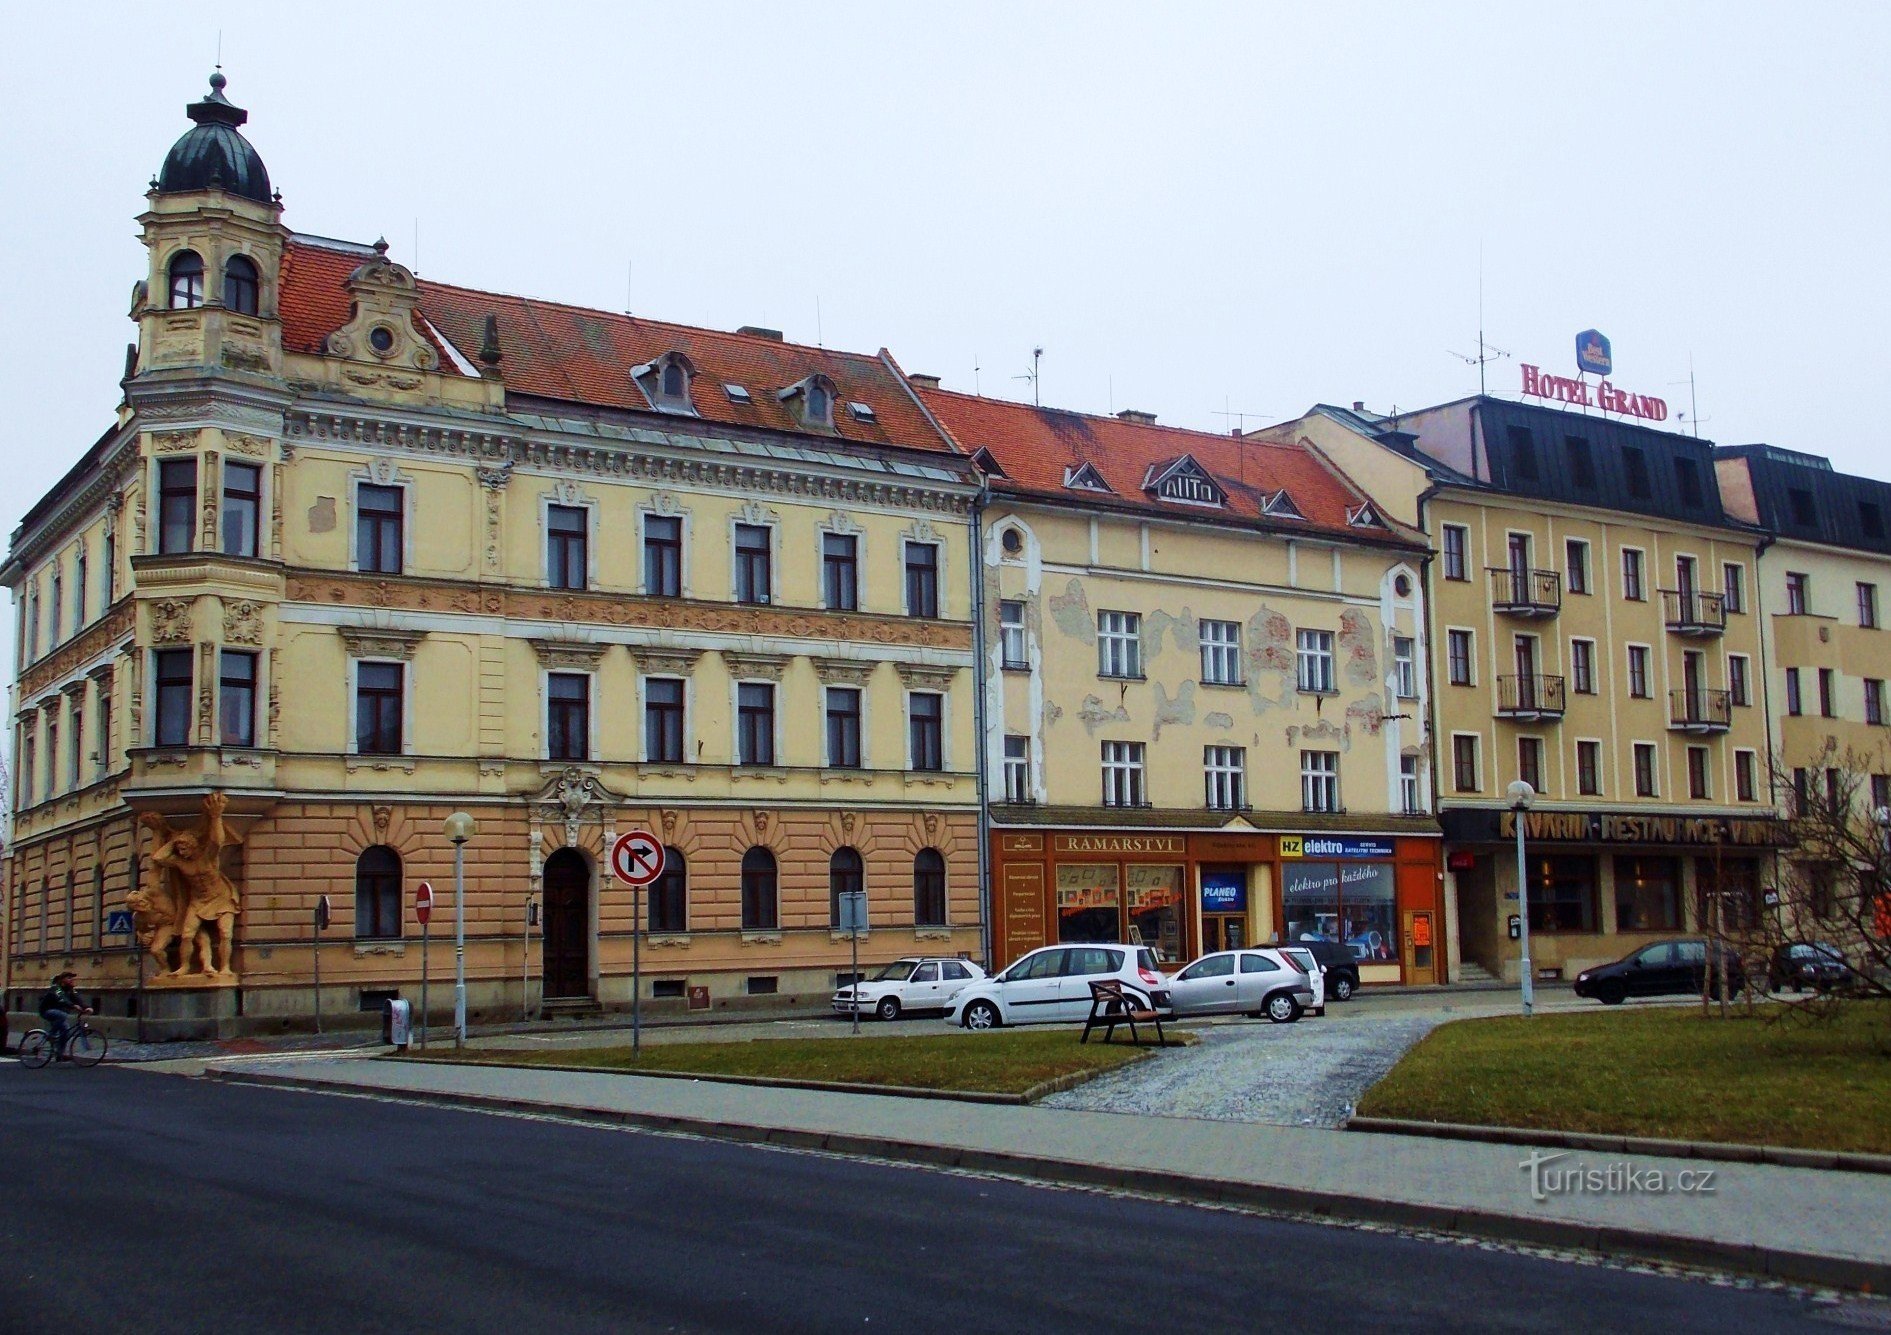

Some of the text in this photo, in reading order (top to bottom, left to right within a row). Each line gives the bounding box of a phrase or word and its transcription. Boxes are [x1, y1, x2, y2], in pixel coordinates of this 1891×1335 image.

[1520, 363, 1668, 421] HOTEL GRAND
[1282, 839, 1343, 854] HZ elektro
[1289, 864, 1379, 893] elektro pro každého
[1204, 887, 1236, 897] PLANEO
